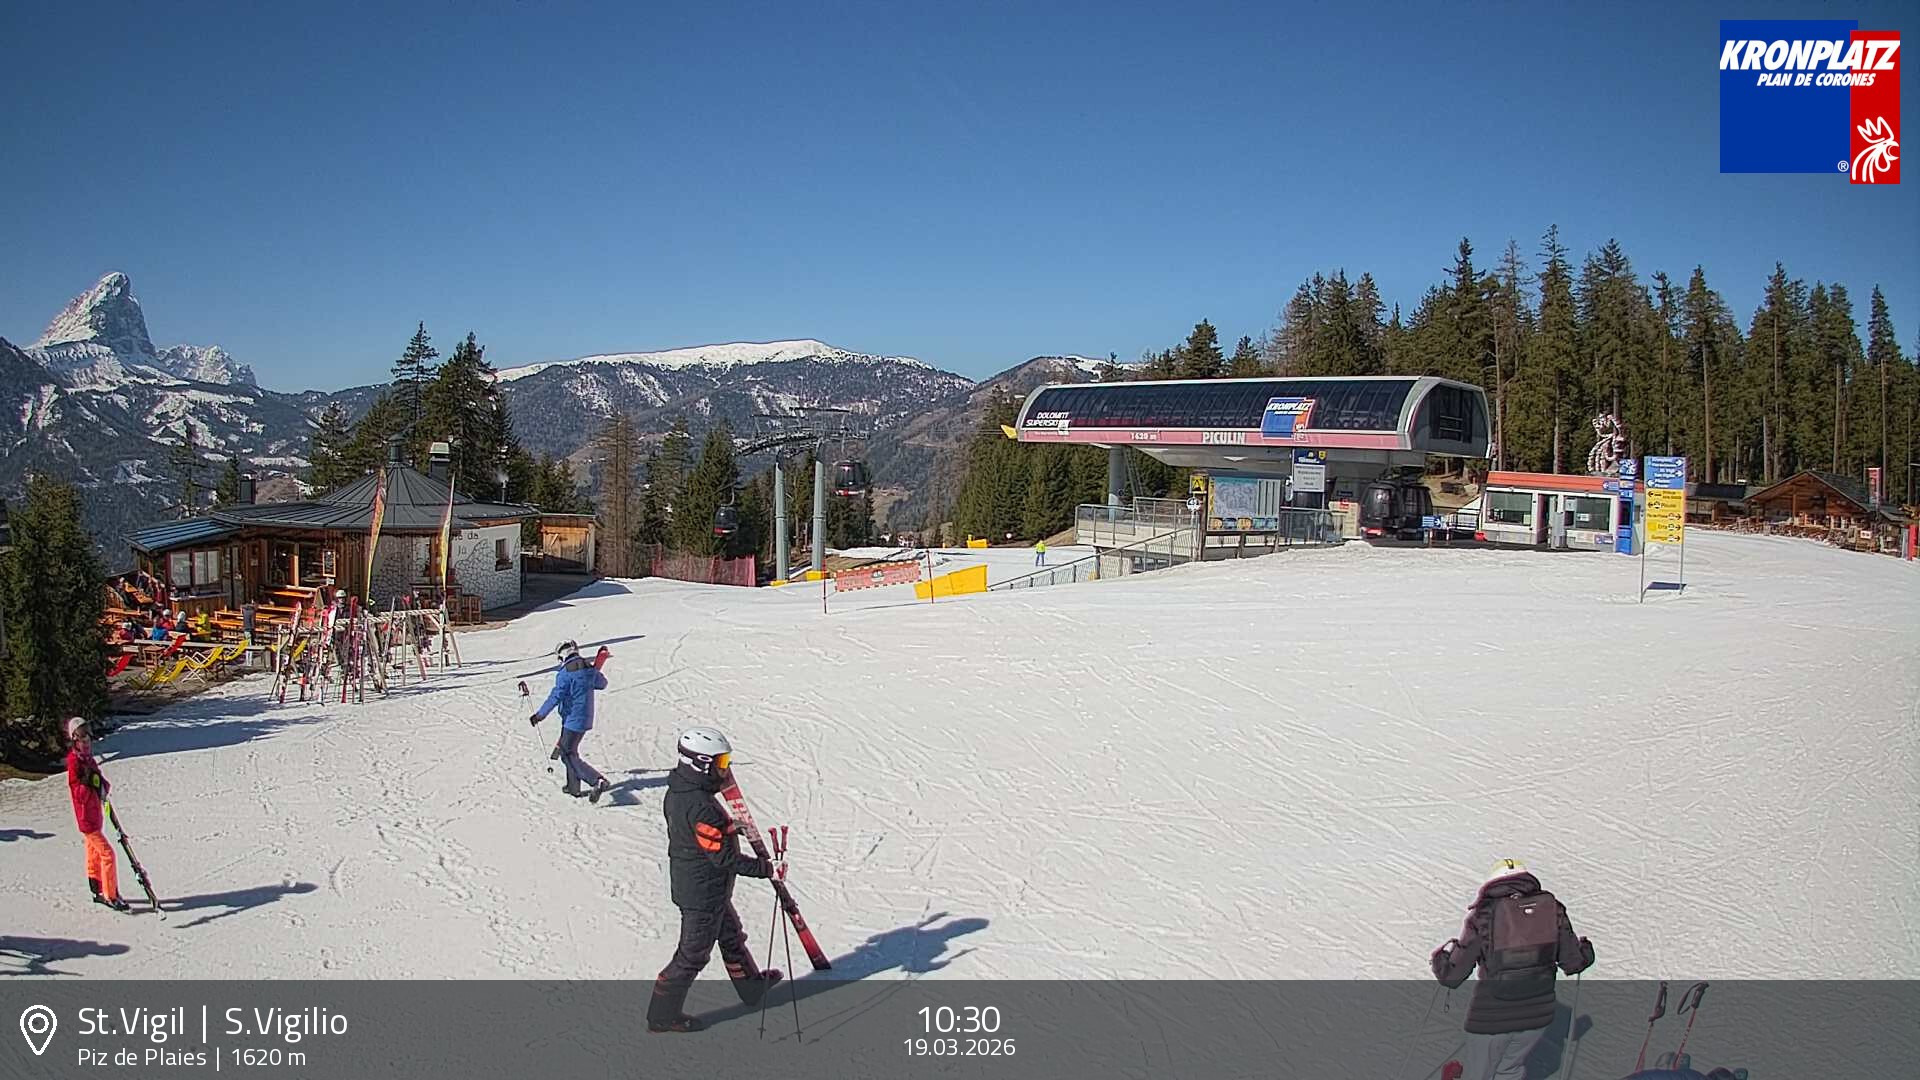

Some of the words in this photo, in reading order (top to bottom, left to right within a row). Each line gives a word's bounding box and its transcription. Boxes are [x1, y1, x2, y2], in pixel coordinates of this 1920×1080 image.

[1036, 411, 1070, 419] DOLOMITI
[1129, 432, 1149, 440] 1620
[1202, 431, 1246, 445] PICULIN
